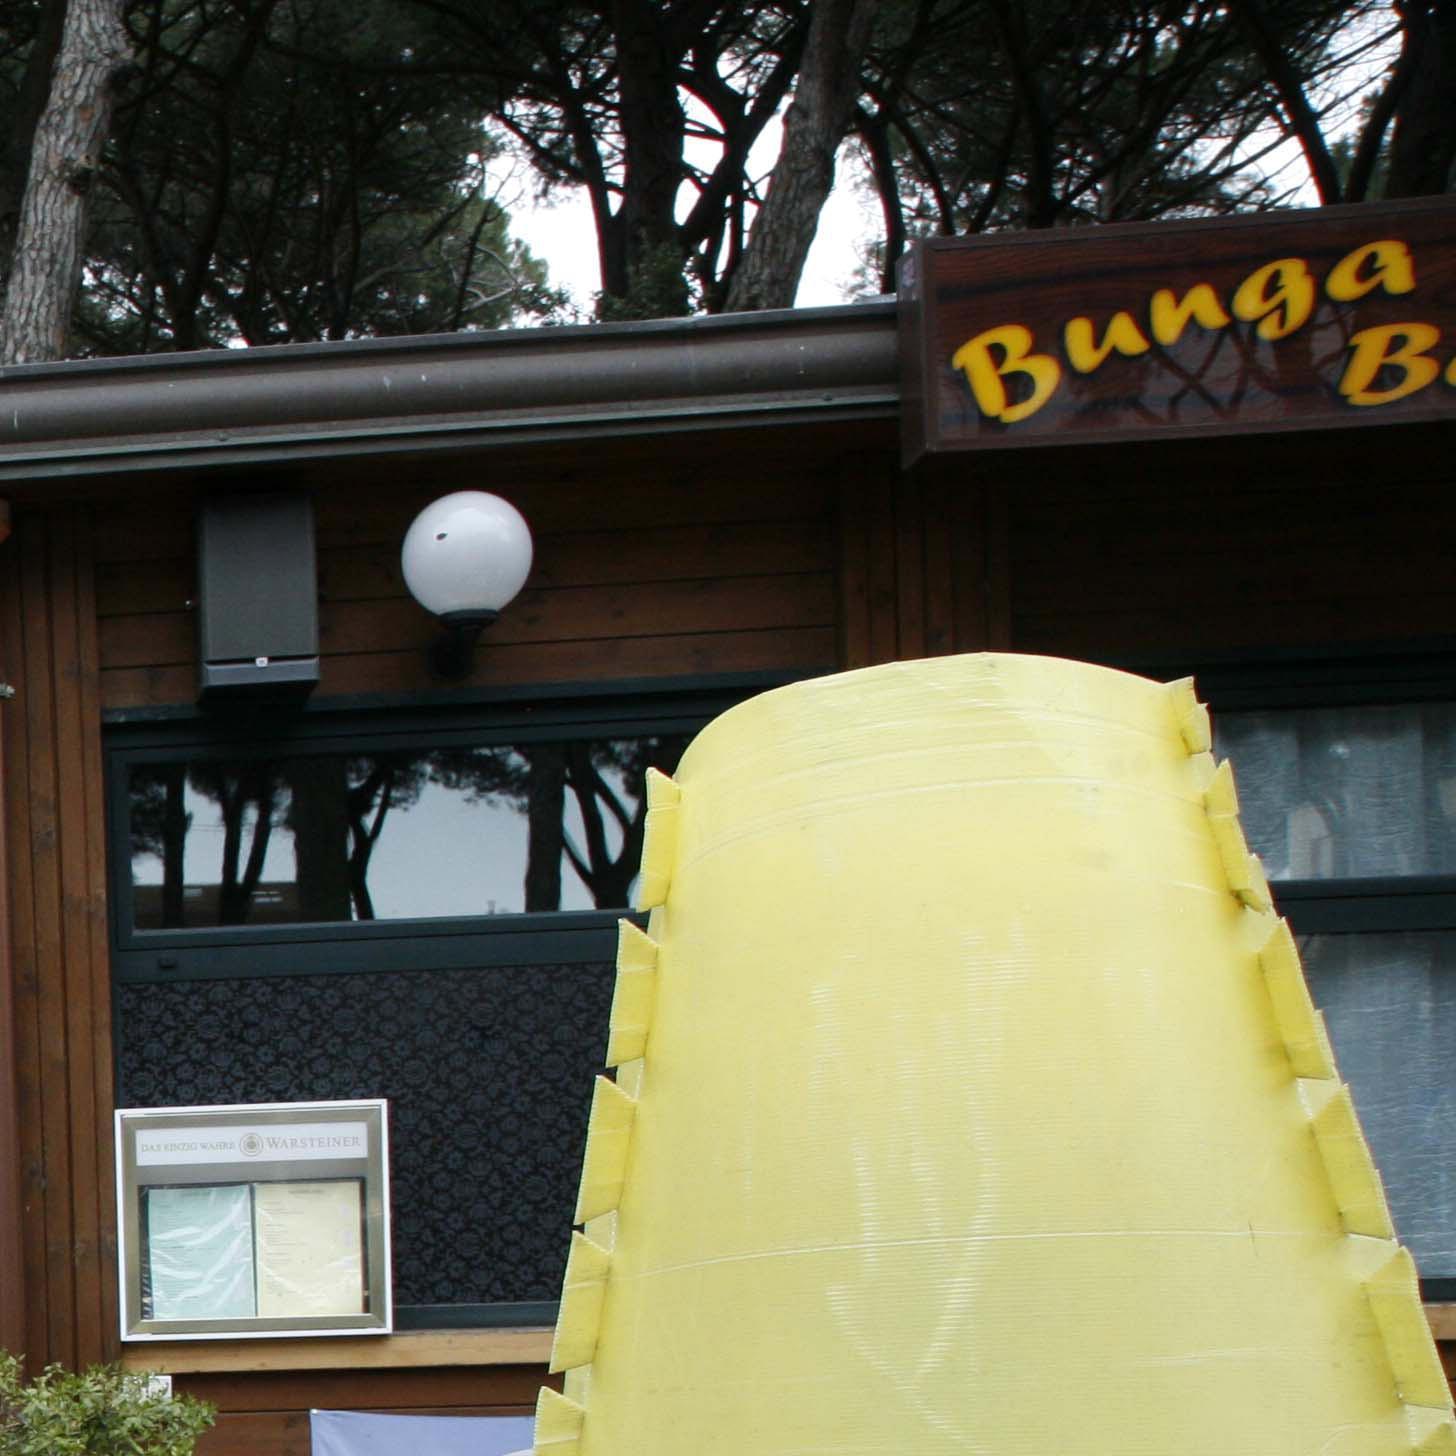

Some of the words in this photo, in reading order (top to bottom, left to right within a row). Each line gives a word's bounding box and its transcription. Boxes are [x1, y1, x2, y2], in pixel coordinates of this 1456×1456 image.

[951, 239, 1417, 424] Bunga
[1339, 322, 1456, 407] B
[265, 1136, 361, 1149] WARSTEINER
